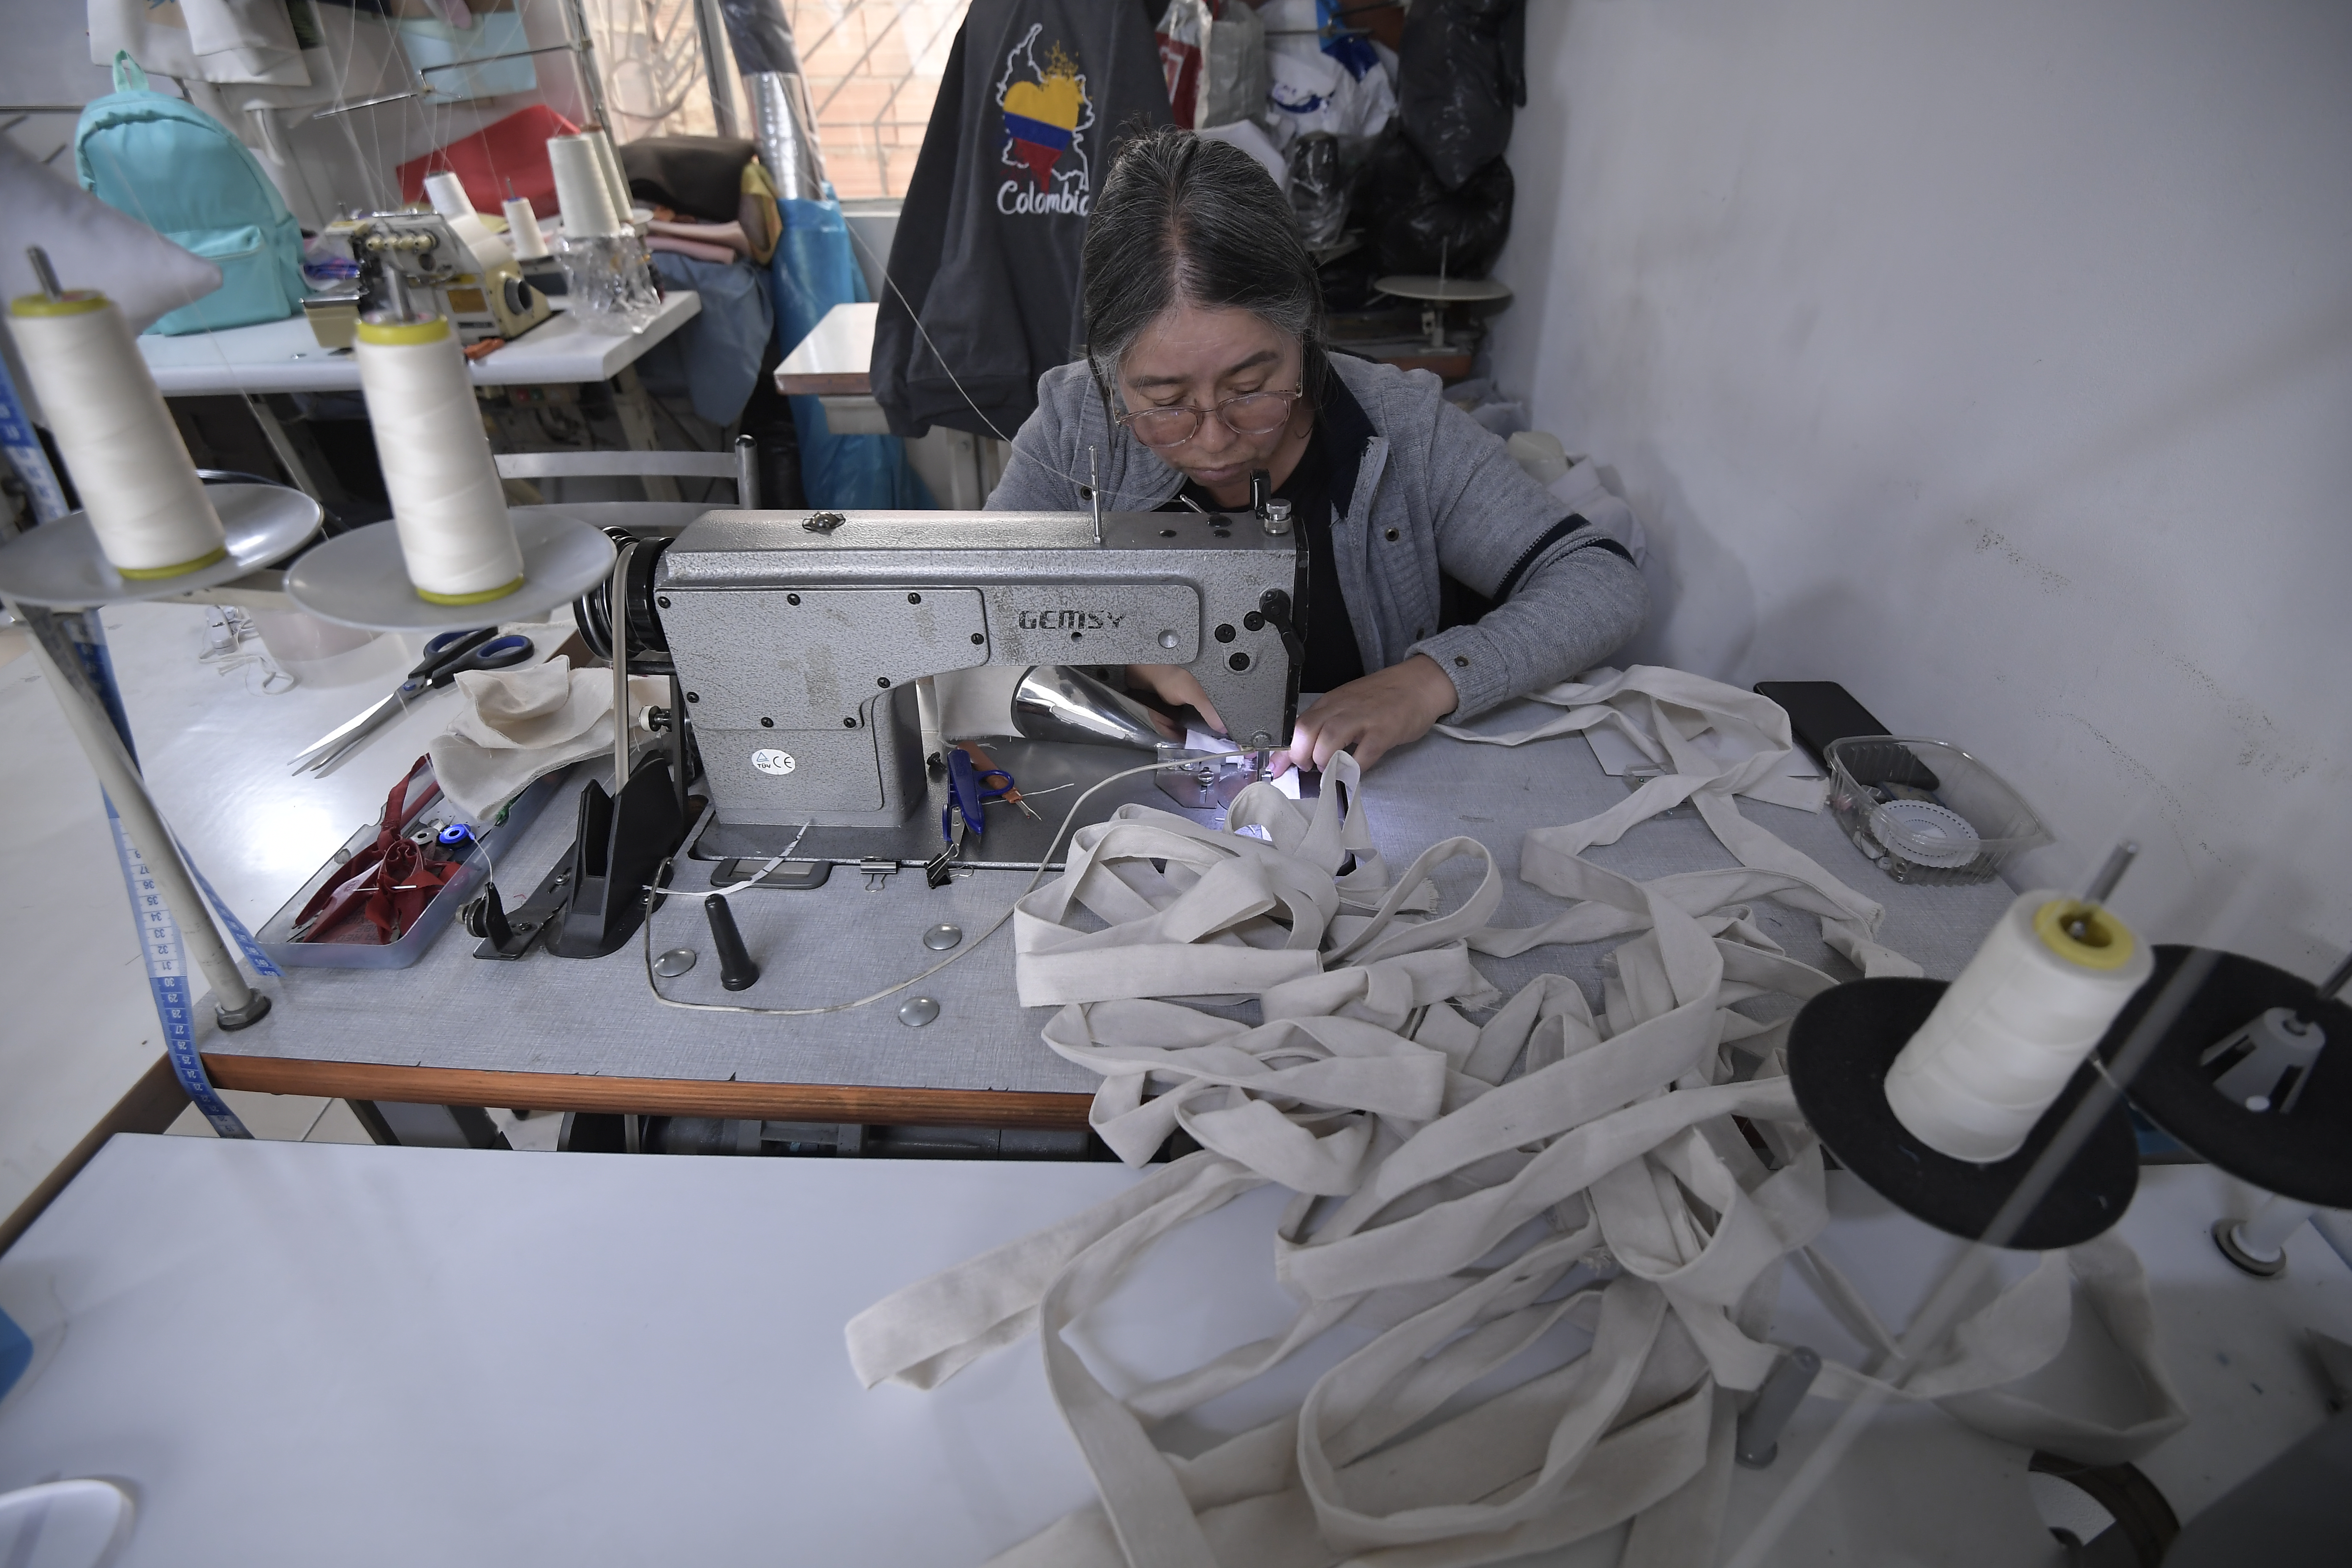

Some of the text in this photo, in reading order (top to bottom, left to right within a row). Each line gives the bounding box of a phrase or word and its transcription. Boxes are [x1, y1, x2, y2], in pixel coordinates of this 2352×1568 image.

[1018, 610, 1125, 629] GEMSY
[773, 756, 792, 769] CE
[143, 880, 155, 890] 36
[147, 896, 159, 906] 35
[151, 912, 162, 922] 34
[154, 929, 166, 938] 33
[158, 945, 169, 954] 32
[162, 961, 172, 970] 31
[164, 977, 175, 987] 30
[168, 994, 178, 1003] 29
[171, 1010, 182, 1018] 28
[175, 1025, 185, 1034] 27
[177, 1041, 187, 1050] 26
[182, 1056, 191, 1064] 25
[187, 1070, 196, 1079] 24
